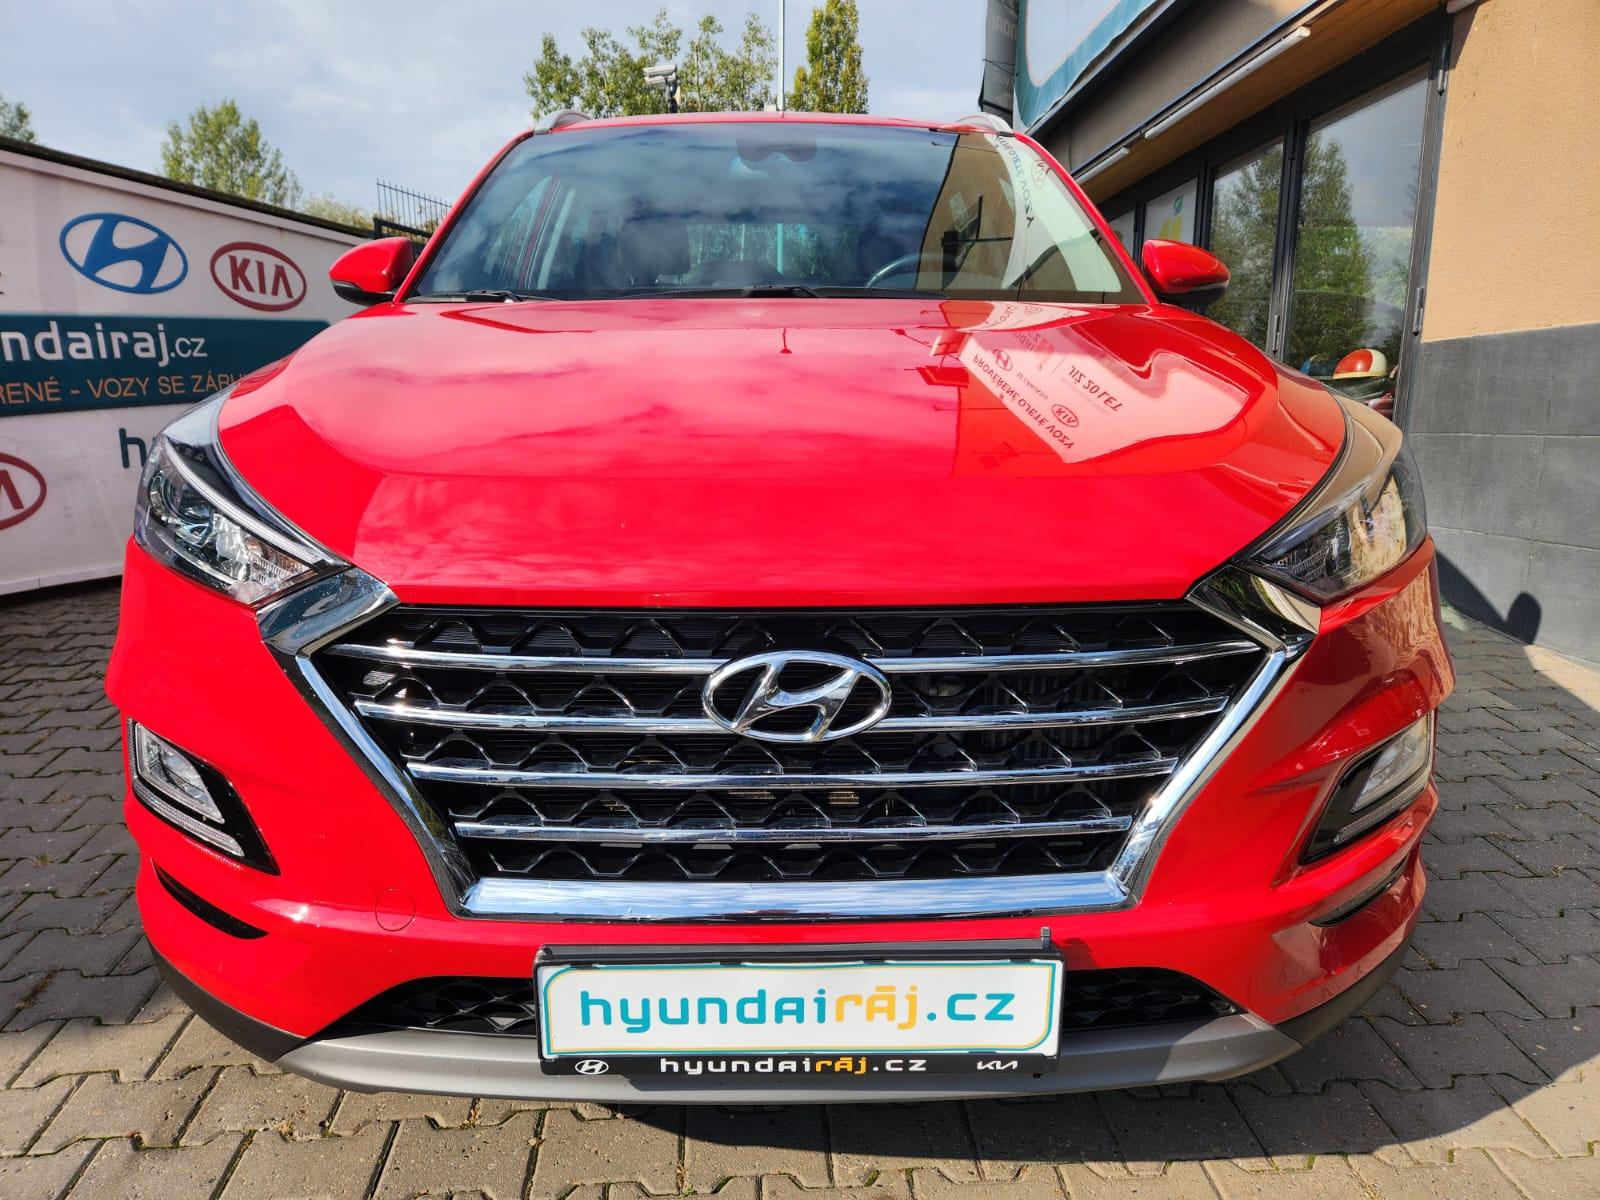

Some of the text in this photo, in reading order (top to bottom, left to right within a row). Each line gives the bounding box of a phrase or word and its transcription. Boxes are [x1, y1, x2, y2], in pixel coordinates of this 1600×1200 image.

[228, 254, 293, 299] KIA
[0, 376, 62, 404] ENÉ
[87, 376, 150, 399] VOZY
[158, 375, 186, 395] SE
